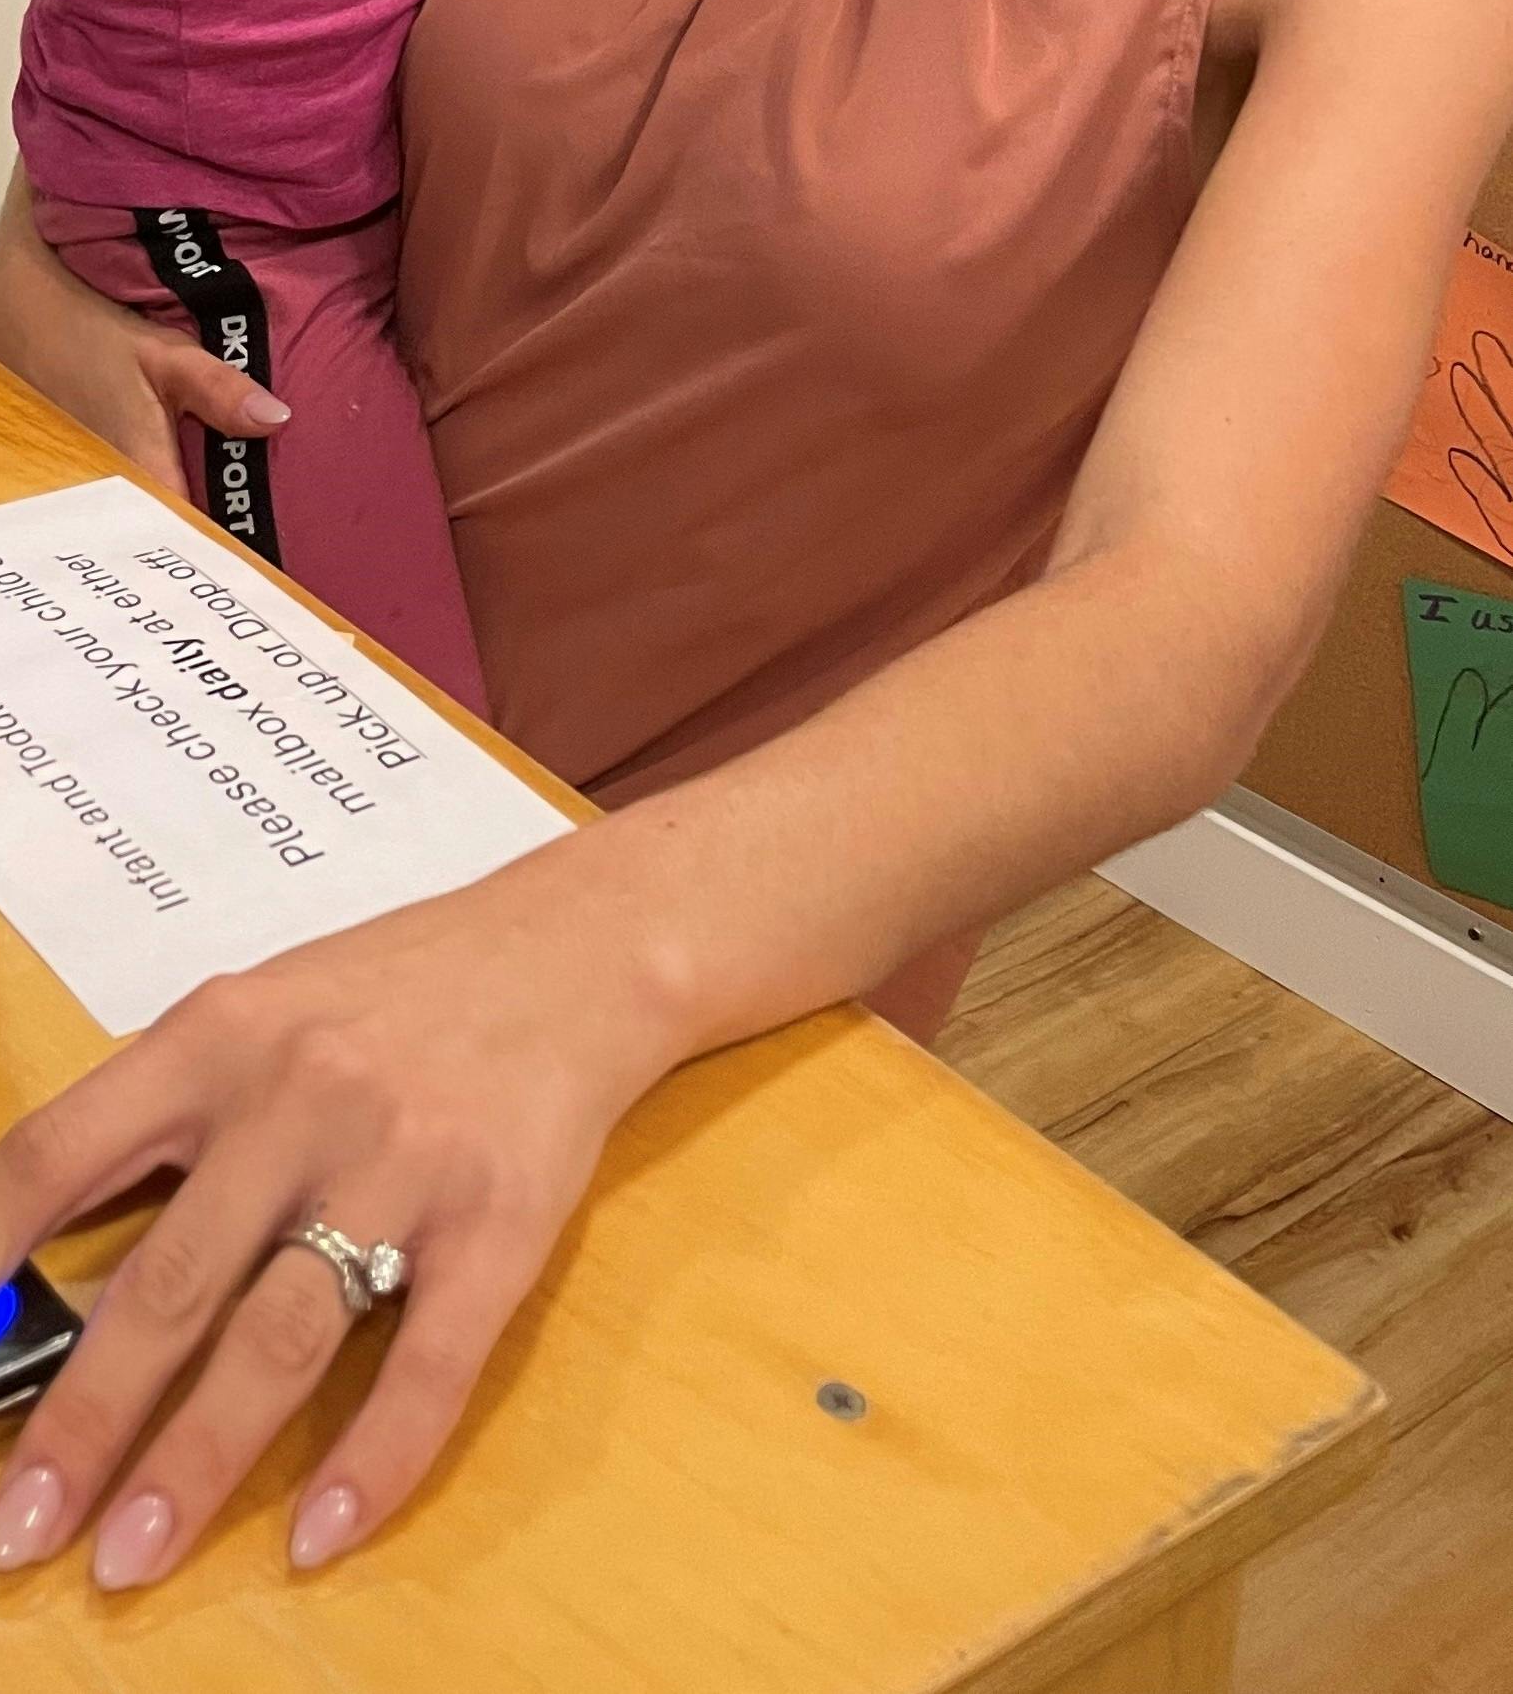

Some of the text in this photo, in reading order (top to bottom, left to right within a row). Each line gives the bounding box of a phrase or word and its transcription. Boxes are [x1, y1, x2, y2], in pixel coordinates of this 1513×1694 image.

[220, 314, 250, 377] DK
[222, 439, 255, 535] PORT
[1418, 593, 1460, 623] I
[53, 627, 139, 679] your
[55, 553, 376, 815] mailbox daily at either
[133, 547, 421, 769] Pick up or Drop off!
[115, 678, 216, 761] check
[40, 774, 109, 826] and
[209, 765, 326, 867] Please
[95, 828, 189, 913] Infant
